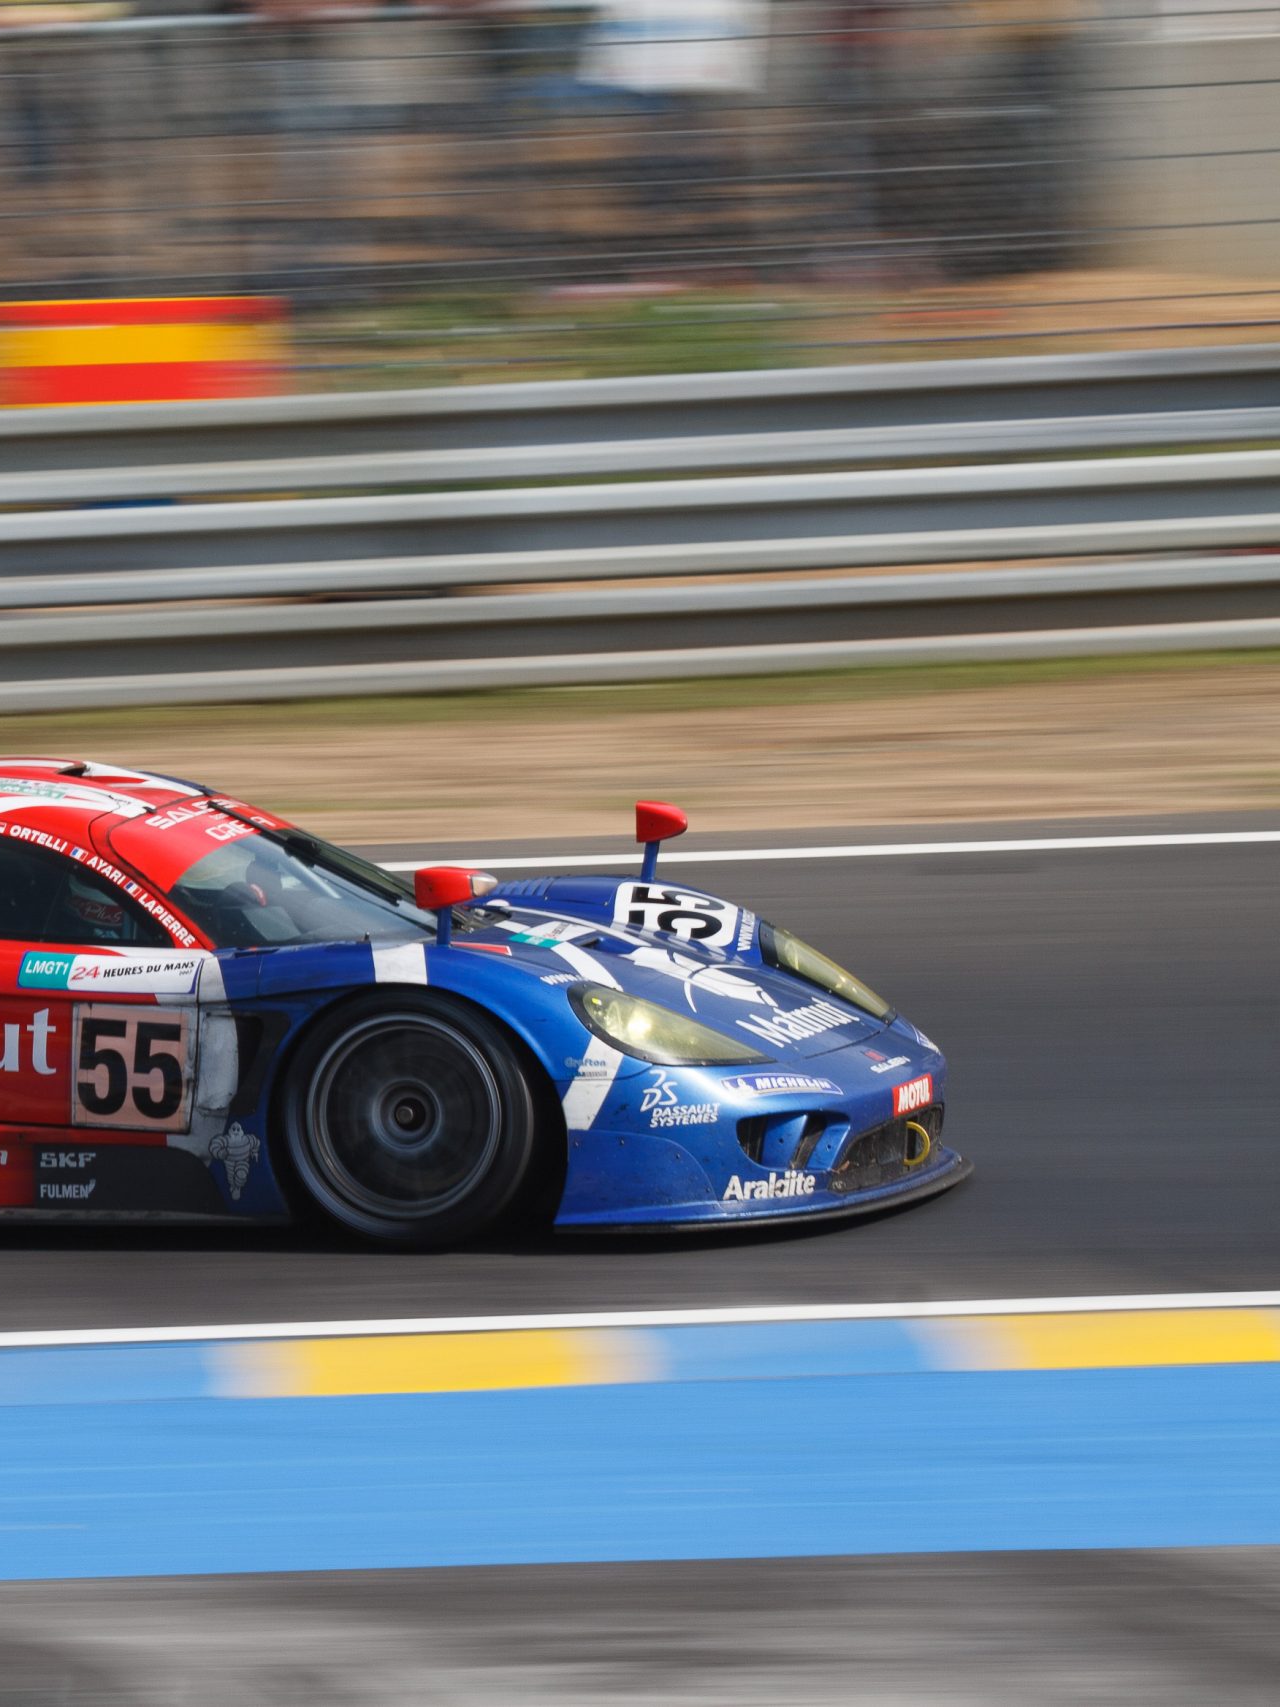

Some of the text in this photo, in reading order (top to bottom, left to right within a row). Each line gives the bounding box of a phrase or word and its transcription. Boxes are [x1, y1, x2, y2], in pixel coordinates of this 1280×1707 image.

[9, 825, 68, 853] ORTELLI
[86, 856, 127, 885] AYARI
[138, 893, 196, 947] LAPIERRE
[25, 959, 70, 976] LMGT1
[71, 960, 195, 981] 24 HEURES DU MANS
[735, 997, 860, 1049] Matmut
[77, 1017, 182, 1120] 55
[755, 1076, 833, 1090] MICHELIN
[897, 1077, 931, 1113] MOTUL
[652, 1103, 721, 1118] DASSAULT
[40, 1153, 97, 1168] SKF
[40, 1184, 89, 1199] FULMEN
[722, 1170, 817, 1201] Araldite
